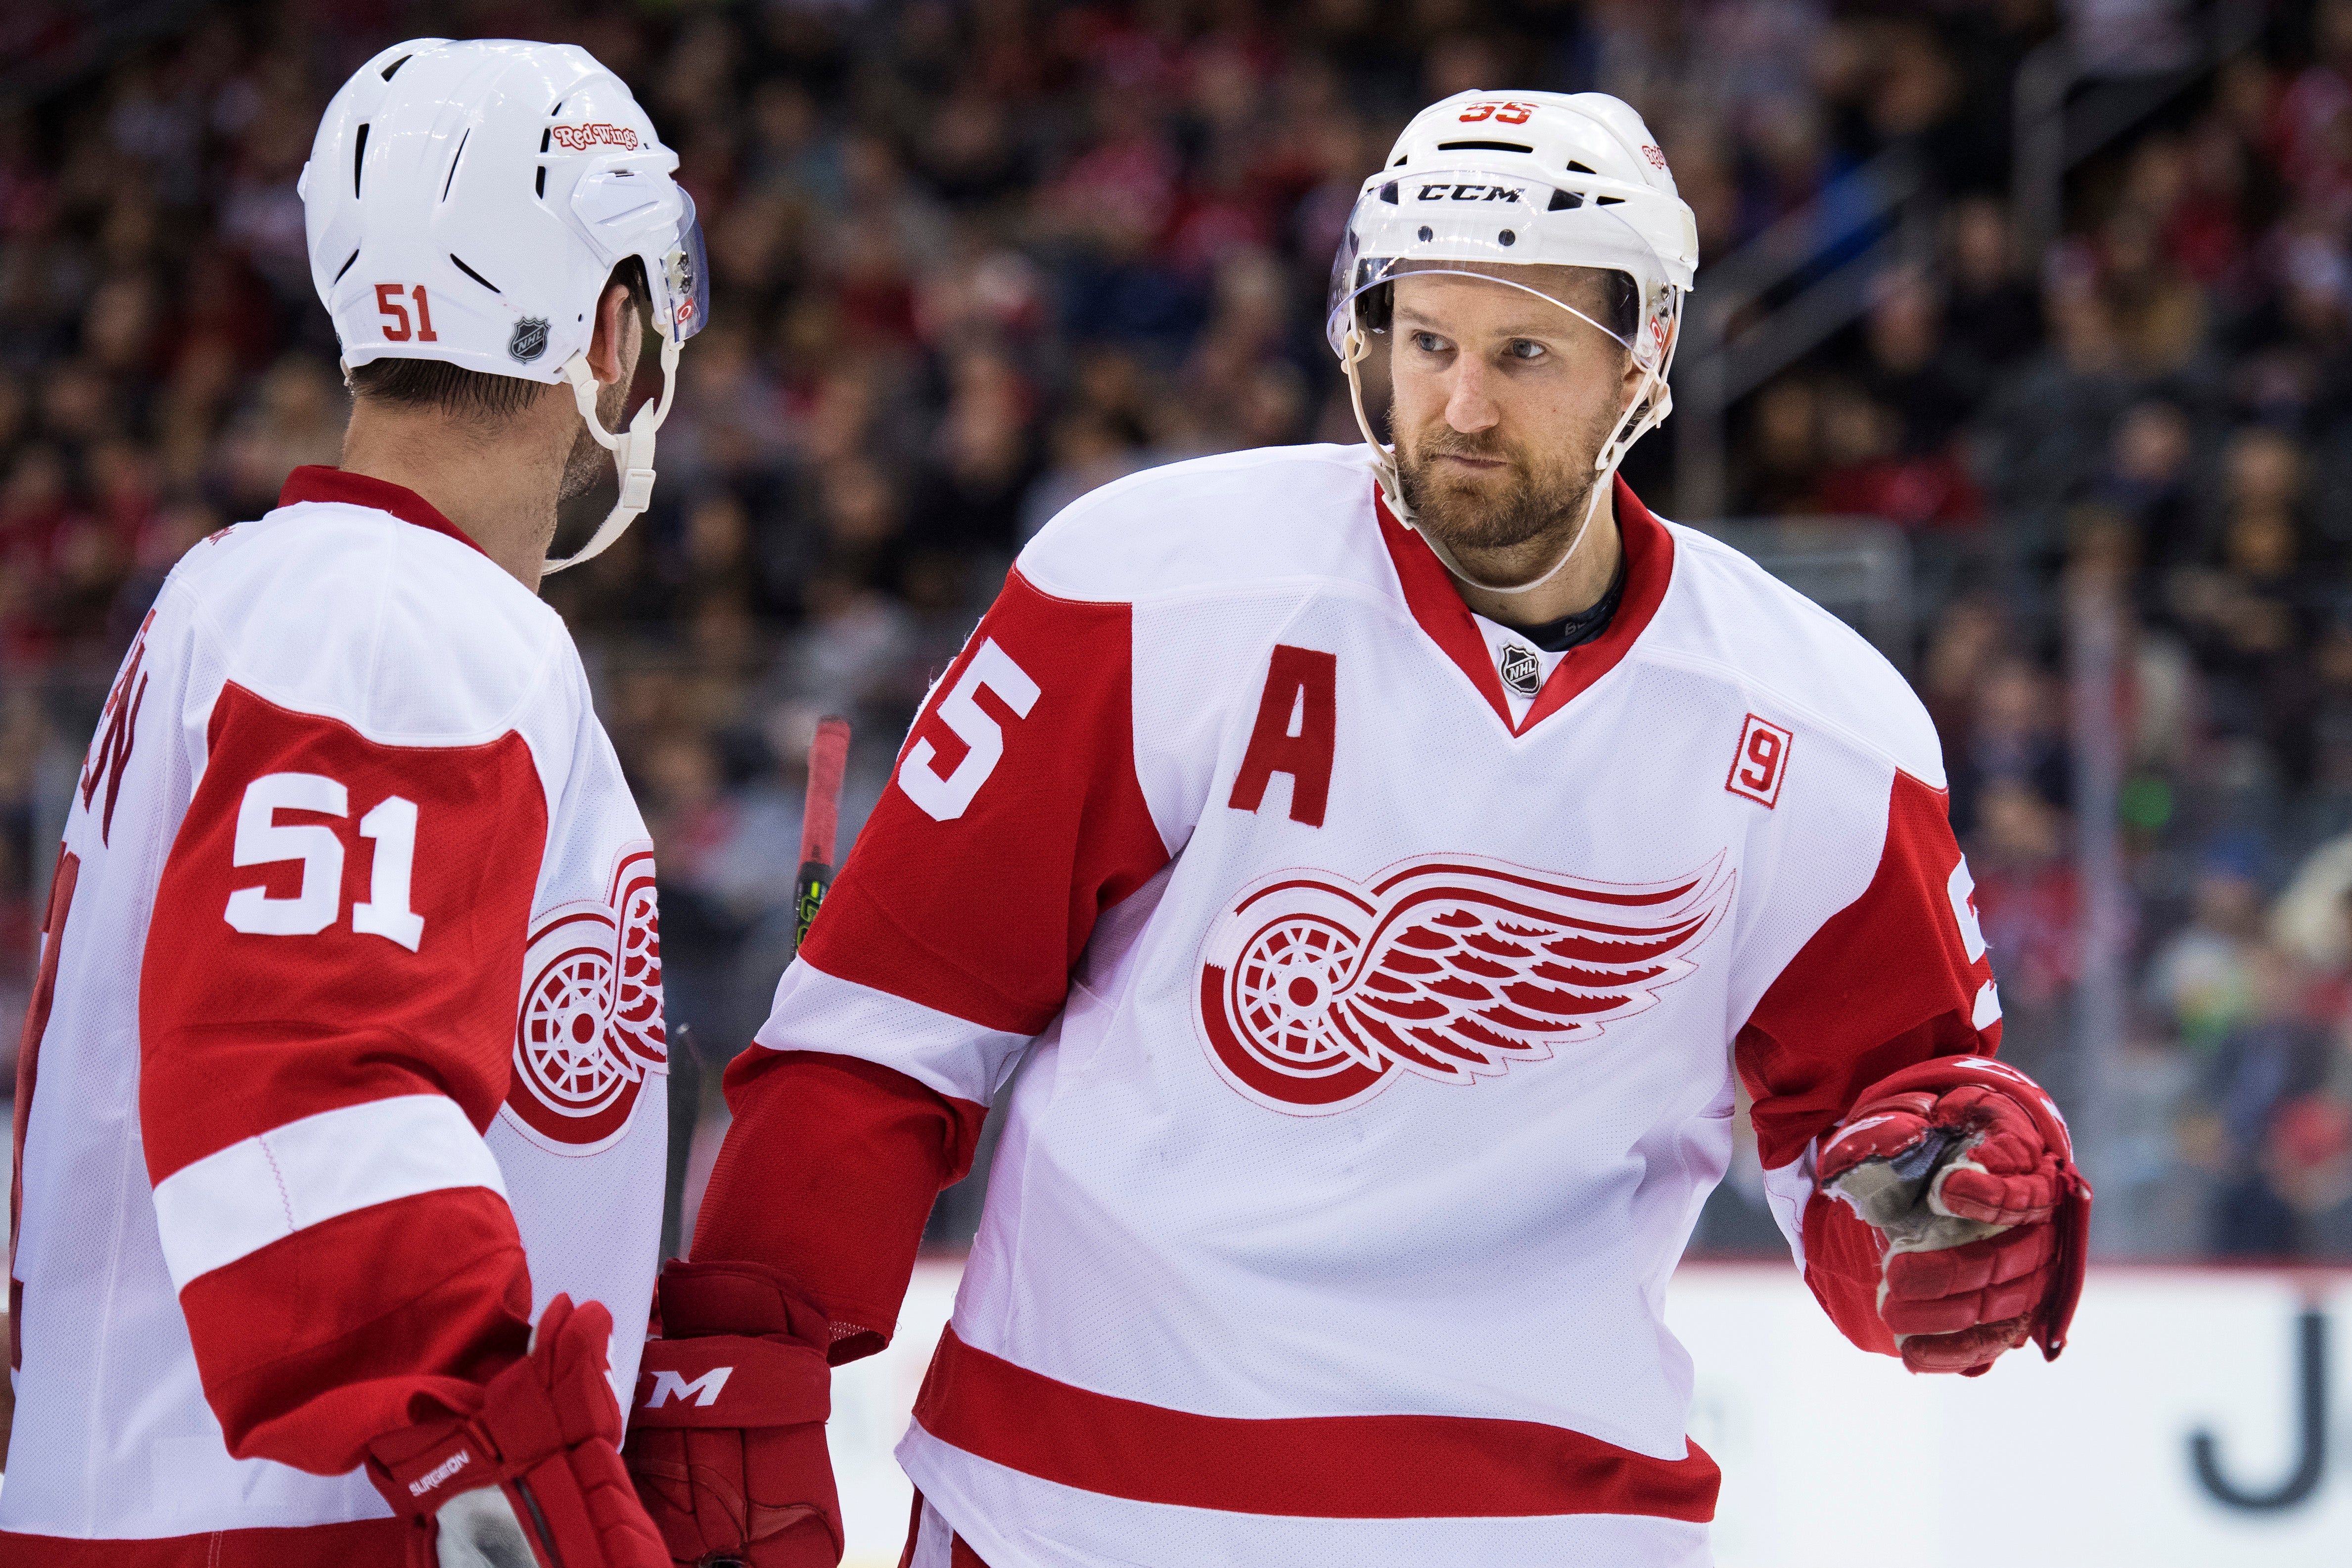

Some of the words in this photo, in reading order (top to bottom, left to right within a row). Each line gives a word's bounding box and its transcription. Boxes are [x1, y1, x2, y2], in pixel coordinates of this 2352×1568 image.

[1459, 101, 1539, 125] 55
[553, 124, 597, 150] Red
[592, 124, 638, 151] Wings
[1418, 184, 1525, 203] CCM
[374, 284, 438, 342] 51
[517, 331, 543, 352] NHL
[1510, 658, 1536, 681] NHL
[896, 615, 1041, 822] 5
[1228, 644, 1337, 829] A
[1740, 728, 1782, 792] 9
[224, 772, 424, 953] 51
[633, 1366, 734, 1408] M
[409, 1449, 469, 1497] SURGEON
